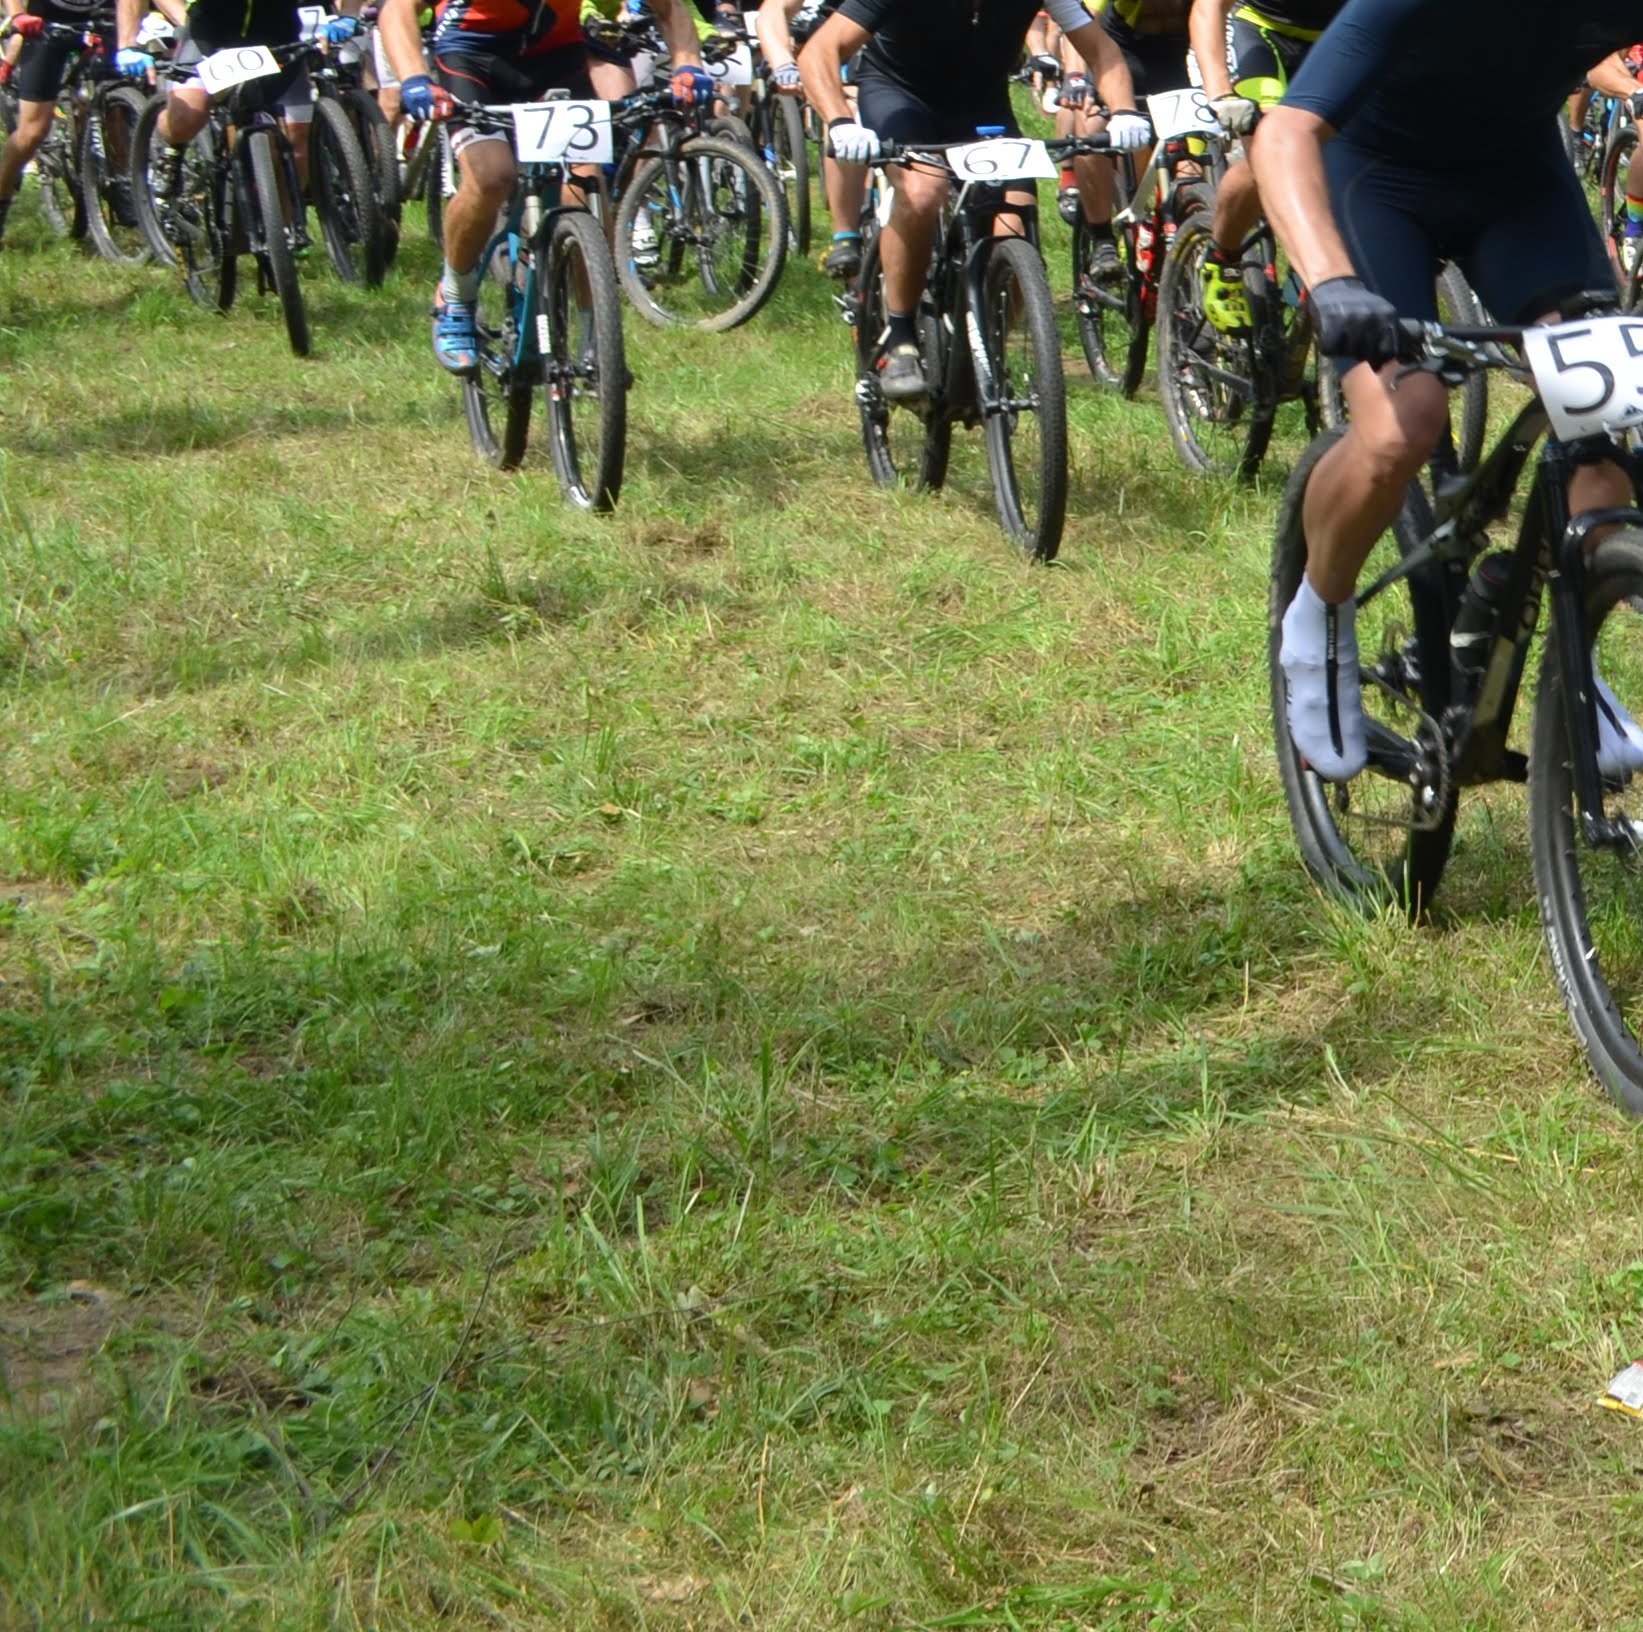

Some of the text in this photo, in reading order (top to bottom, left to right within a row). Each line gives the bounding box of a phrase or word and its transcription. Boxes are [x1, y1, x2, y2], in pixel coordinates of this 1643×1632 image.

[1159, 91, 1216, 125] 78
[523, 104, 599, 150] 73
[963, 141, 1032, 175] 67
